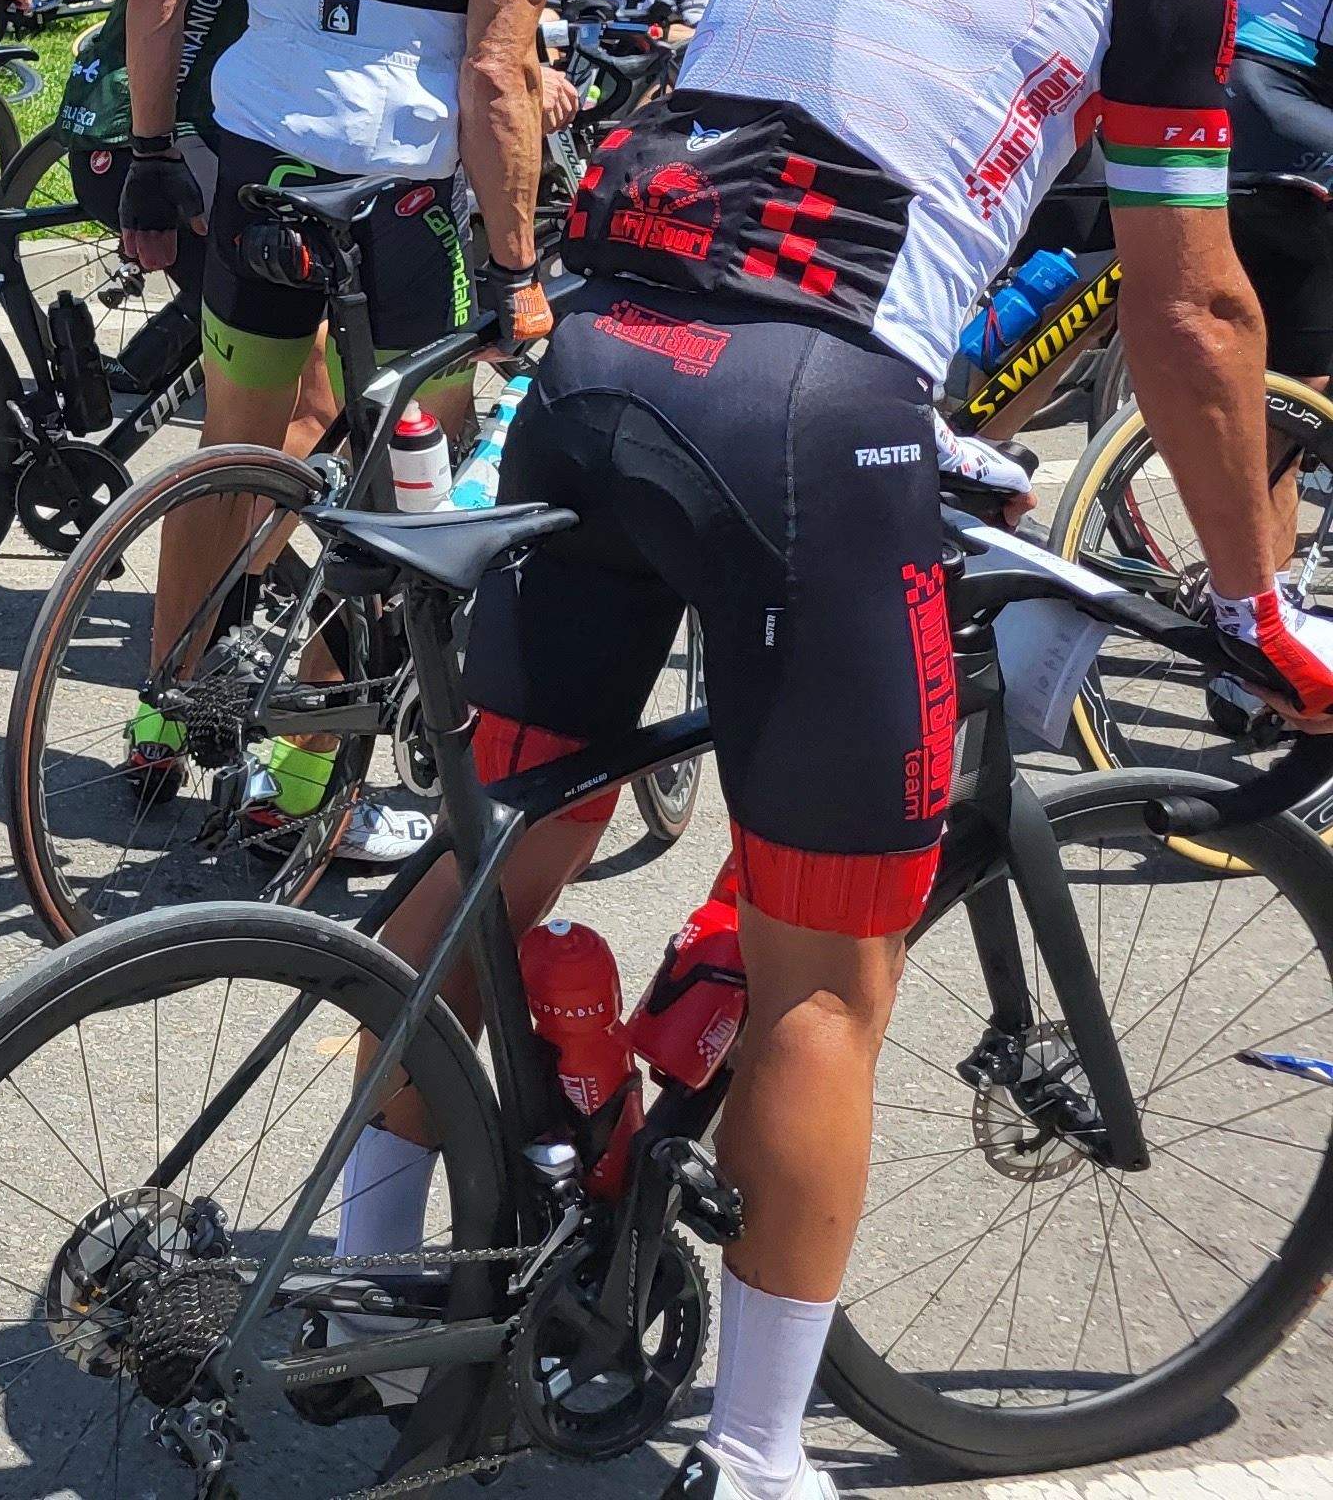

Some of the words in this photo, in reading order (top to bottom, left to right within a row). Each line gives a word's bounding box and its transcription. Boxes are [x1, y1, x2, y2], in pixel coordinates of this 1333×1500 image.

[980, 55, 1084, 191] NutriSport
[422, 204, 471, 327] cannondale
[854, 443, 921, 468] FASTER
[764, 613, 776, 648] FASTER
[904, 749, 923, 821] team
